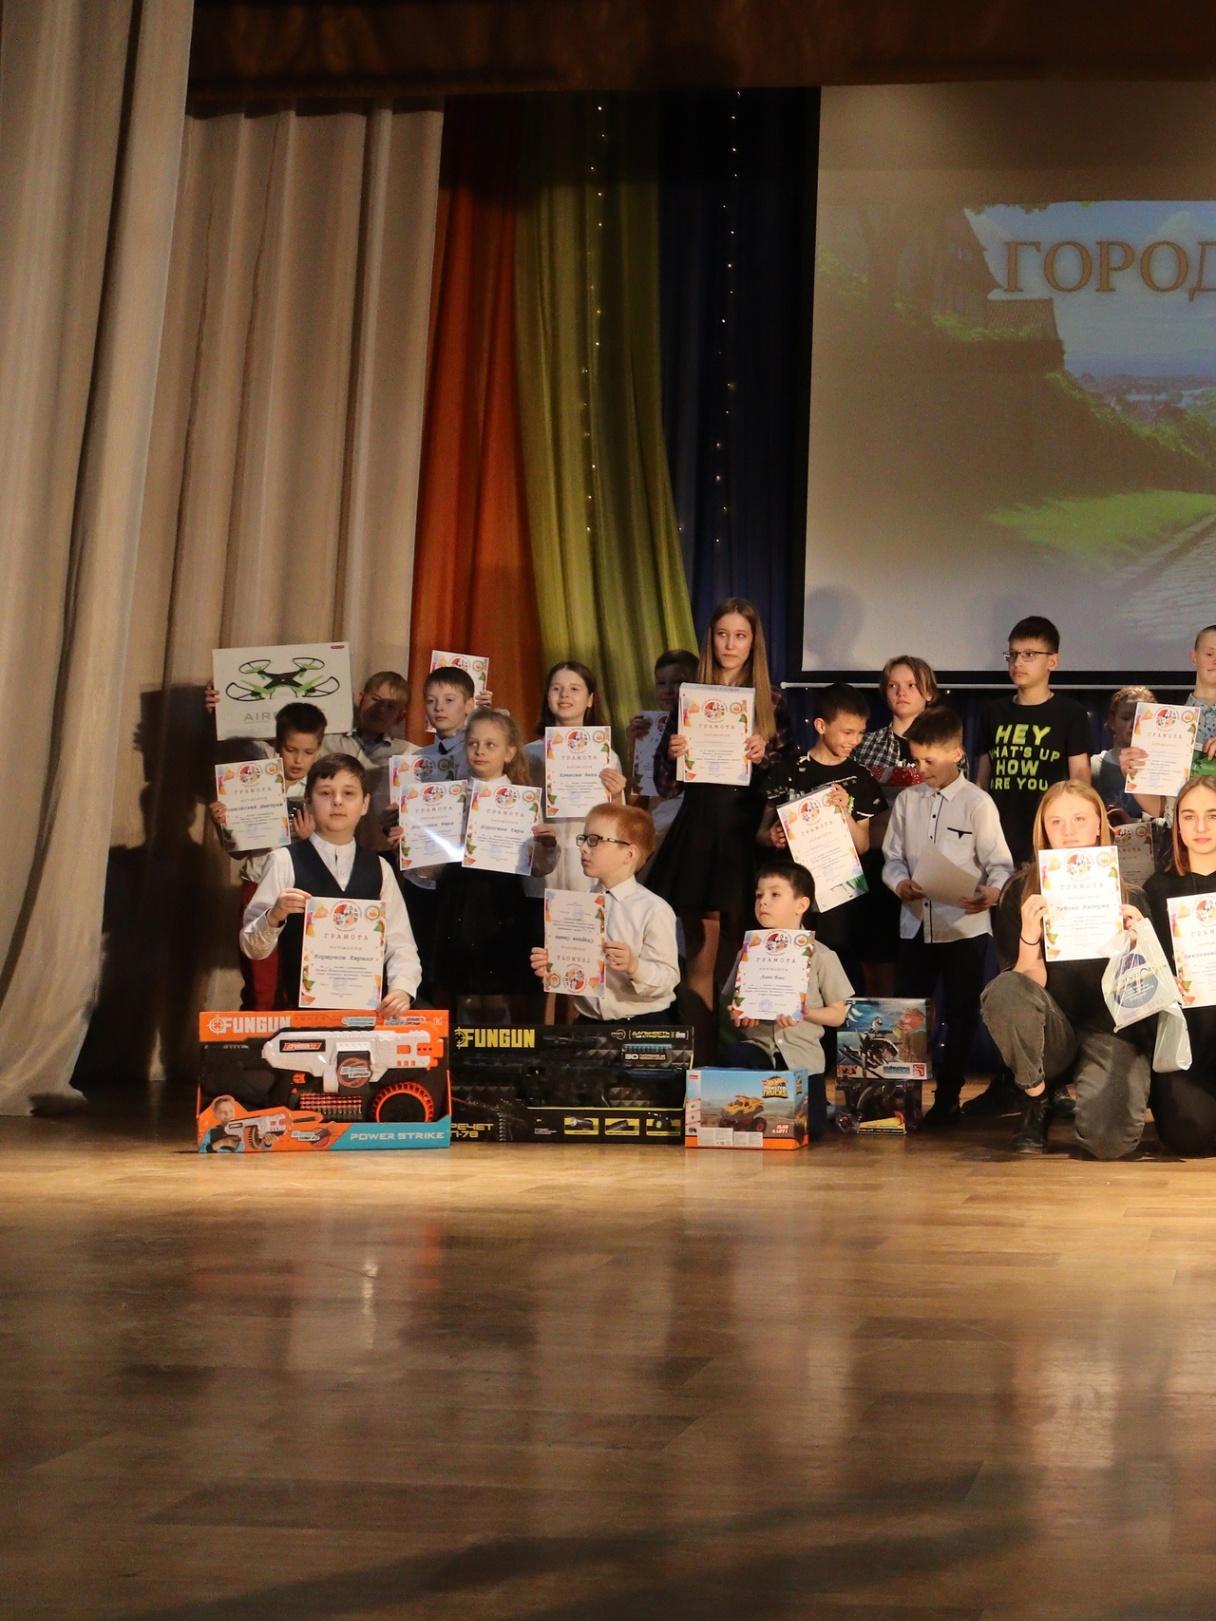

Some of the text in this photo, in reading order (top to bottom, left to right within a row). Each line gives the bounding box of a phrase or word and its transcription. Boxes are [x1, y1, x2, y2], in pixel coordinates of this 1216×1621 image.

[995, 724, 1051, 745] HEY
[1040, 748, 1061, 762] UP
[996, 759, 1039, 775] HOW
[1016, 778, 1048, 791] YOU
[464, 1029, 535, 1048] FUNGUN
[350, 1131, 445, 1141] POWER STRIKE
